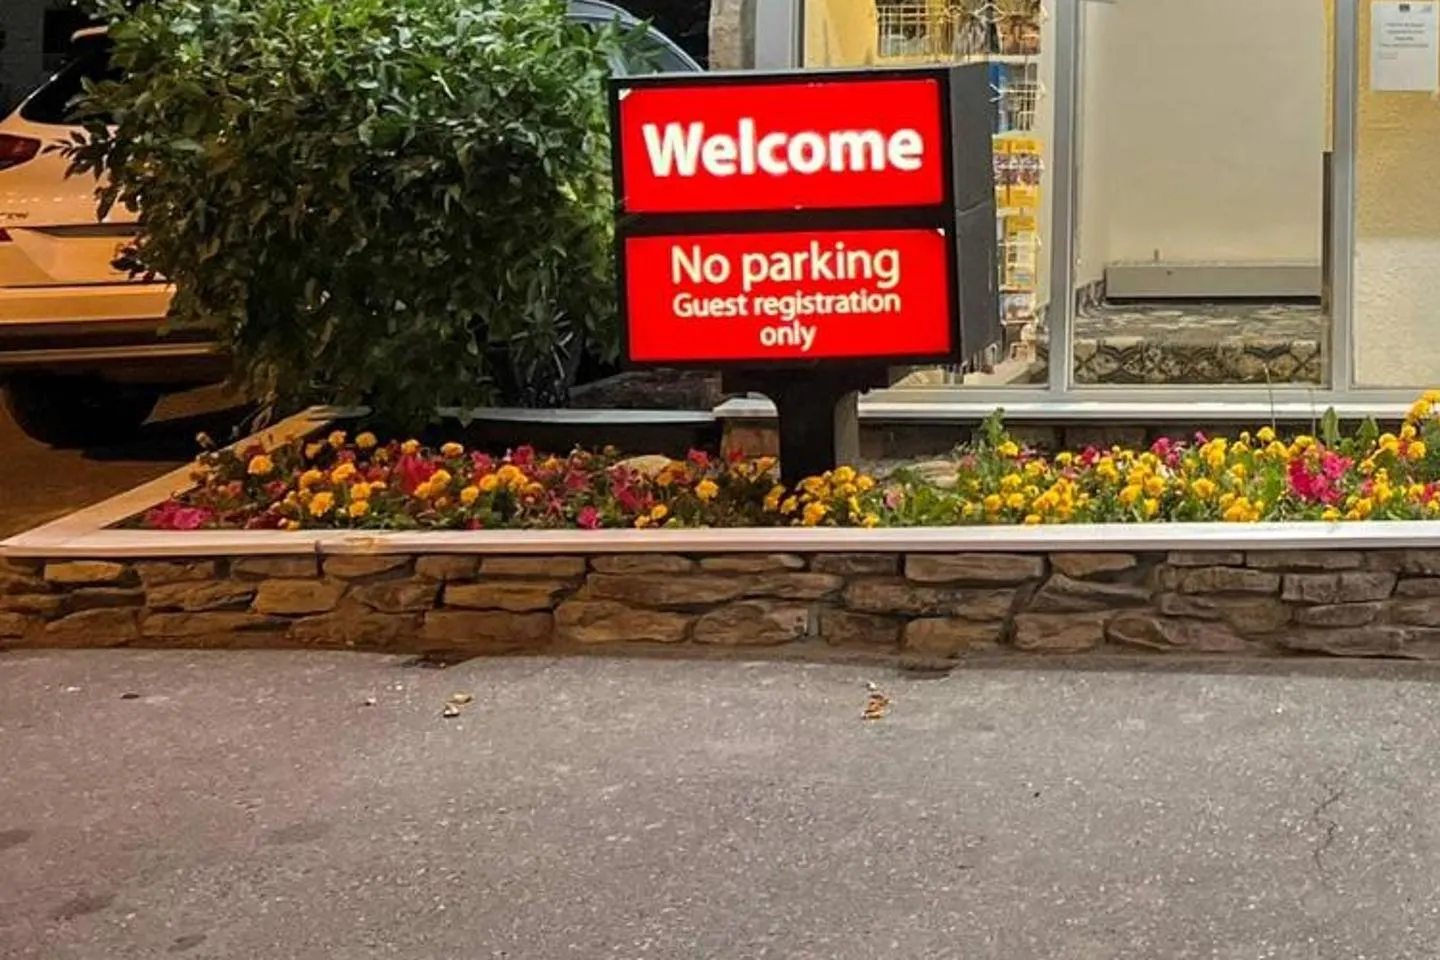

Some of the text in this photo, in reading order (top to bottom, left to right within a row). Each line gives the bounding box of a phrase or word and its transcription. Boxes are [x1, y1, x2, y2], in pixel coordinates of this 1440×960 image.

[643, 118, 923, 176] Welcome
[672, 241, 899, 292] No parking
[673, 290, 900, 321] Guest registration
[760, 320, 816, 350] only
